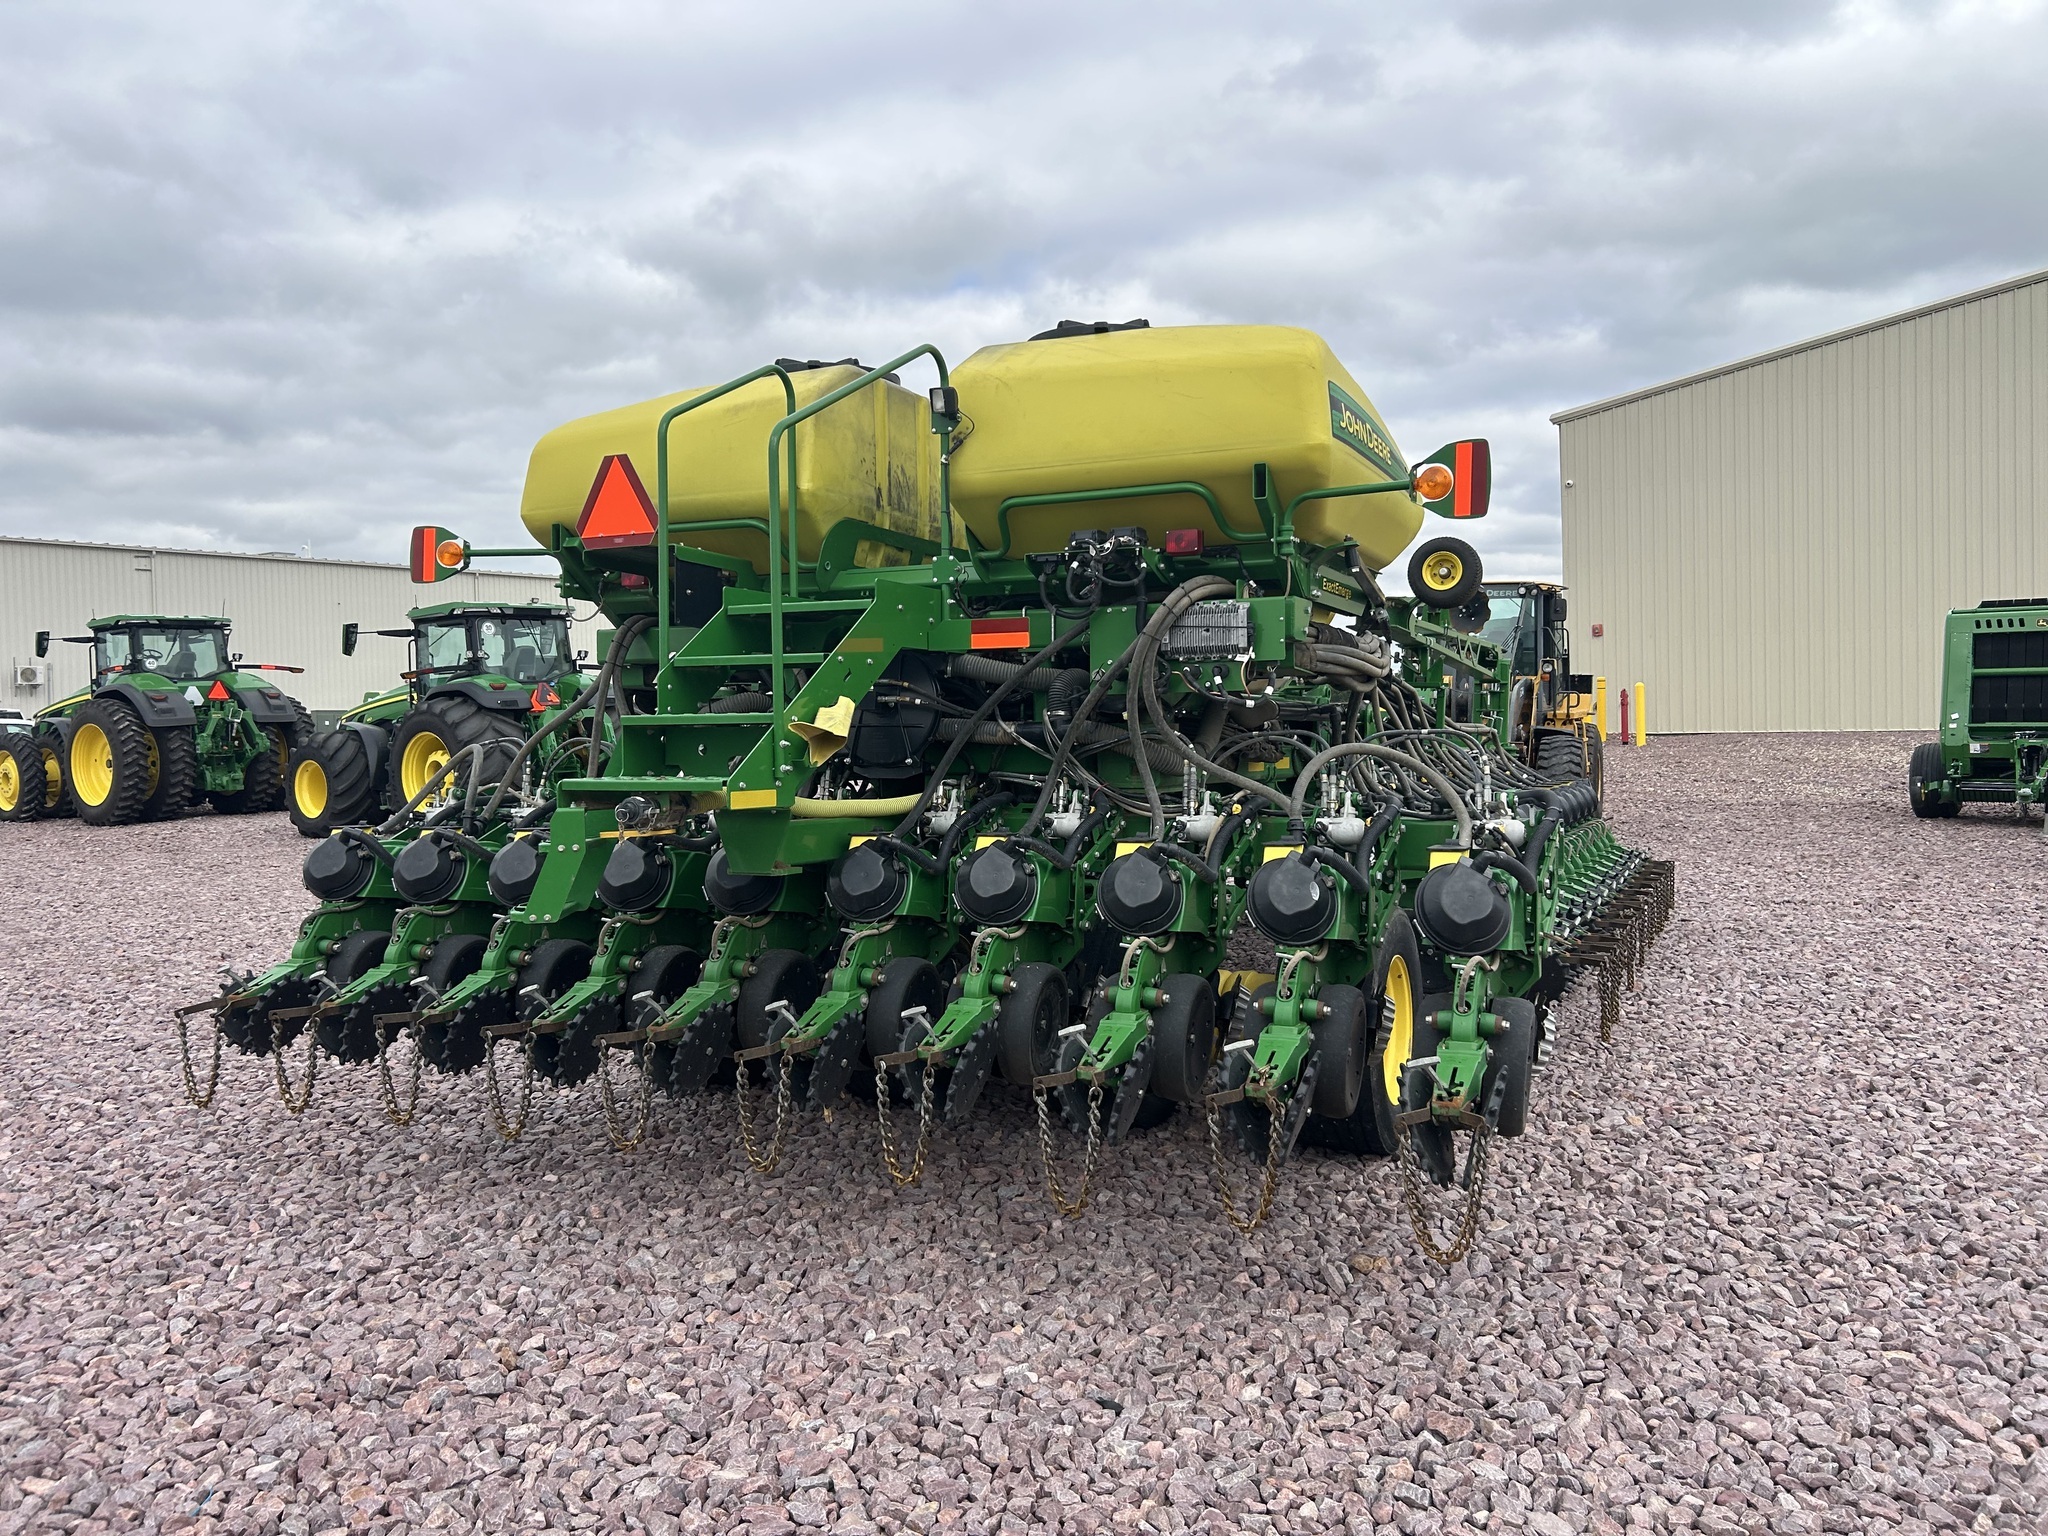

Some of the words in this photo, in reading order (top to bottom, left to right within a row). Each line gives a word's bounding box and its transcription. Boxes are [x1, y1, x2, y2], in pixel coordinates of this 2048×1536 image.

[1340, 402, 1367, 444] JOHN
[1366, 423, 1392, 465] DEERE
[1322, 577, 1352, 600] ExactEmerge
[1486, 589, 1518, 597] DEERE
